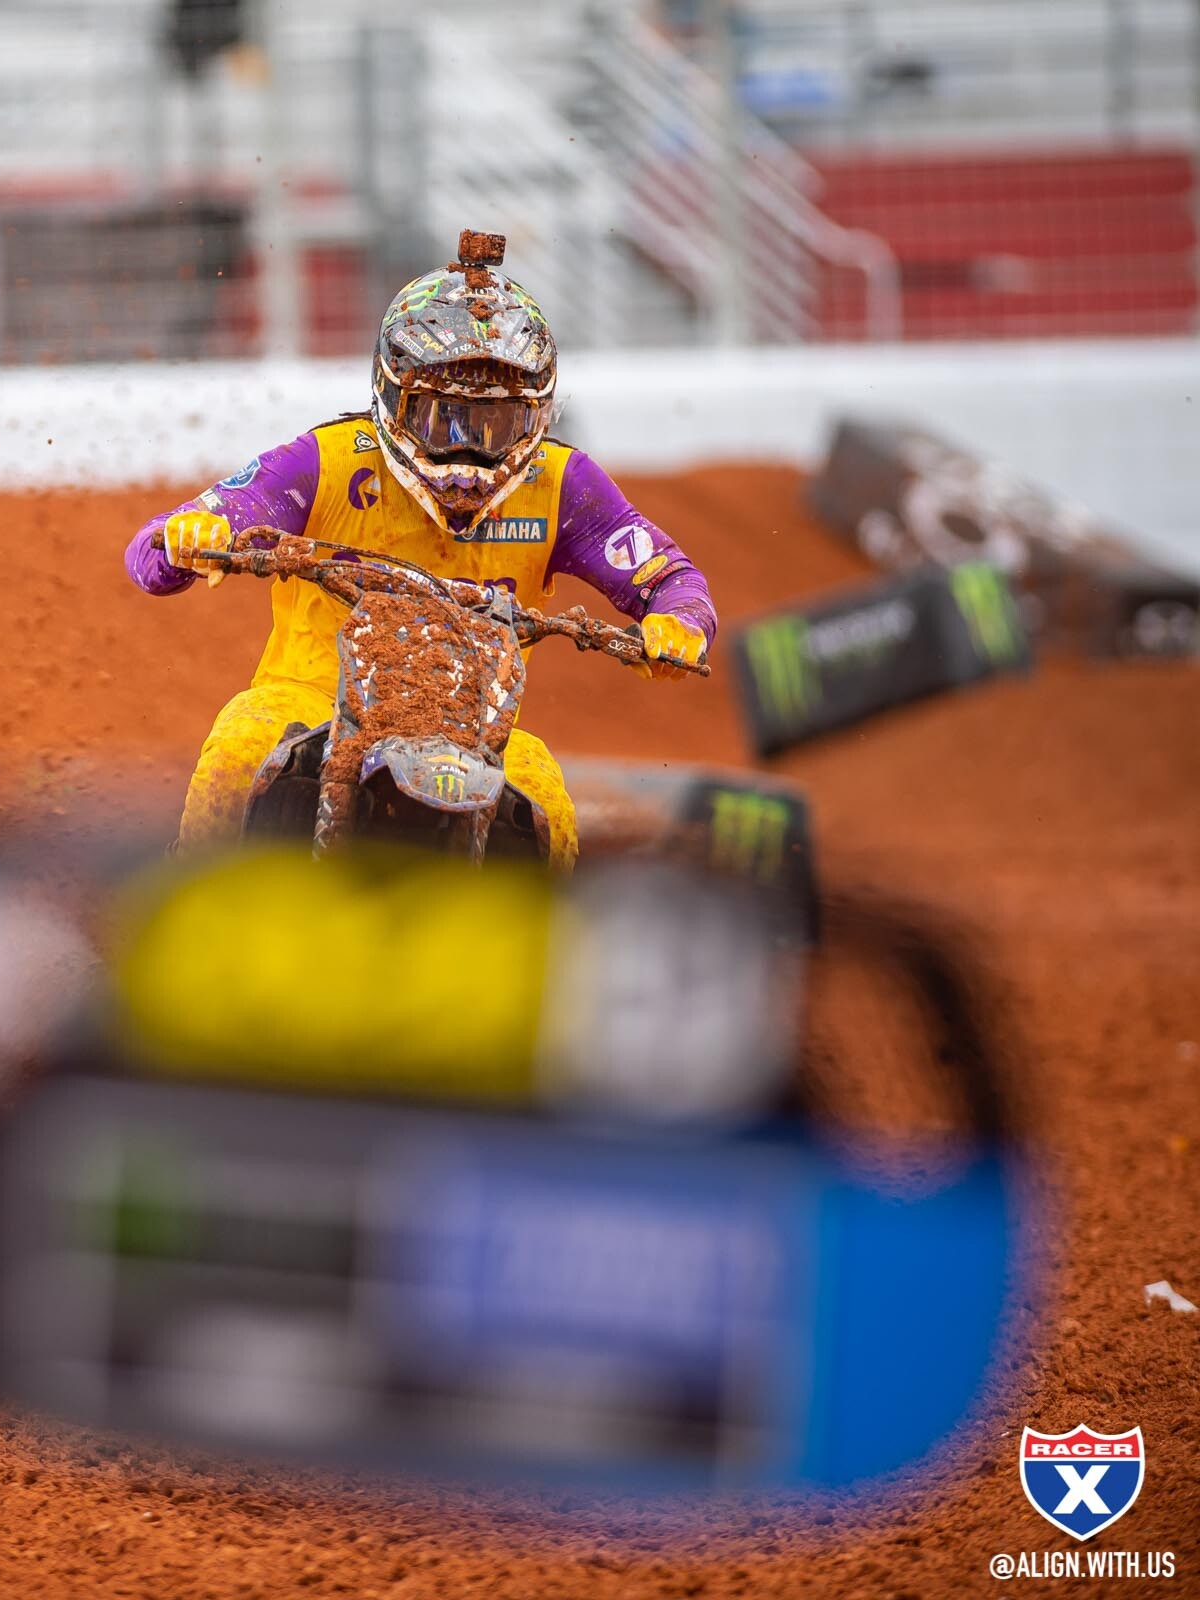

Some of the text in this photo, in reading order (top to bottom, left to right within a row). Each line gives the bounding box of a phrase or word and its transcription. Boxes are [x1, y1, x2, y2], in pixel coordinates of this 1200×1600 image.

[484, 522, 541, 540] AMAHA
[611, 528, 637, 567] 7
[430, 765, 466, 777] YMAHA
